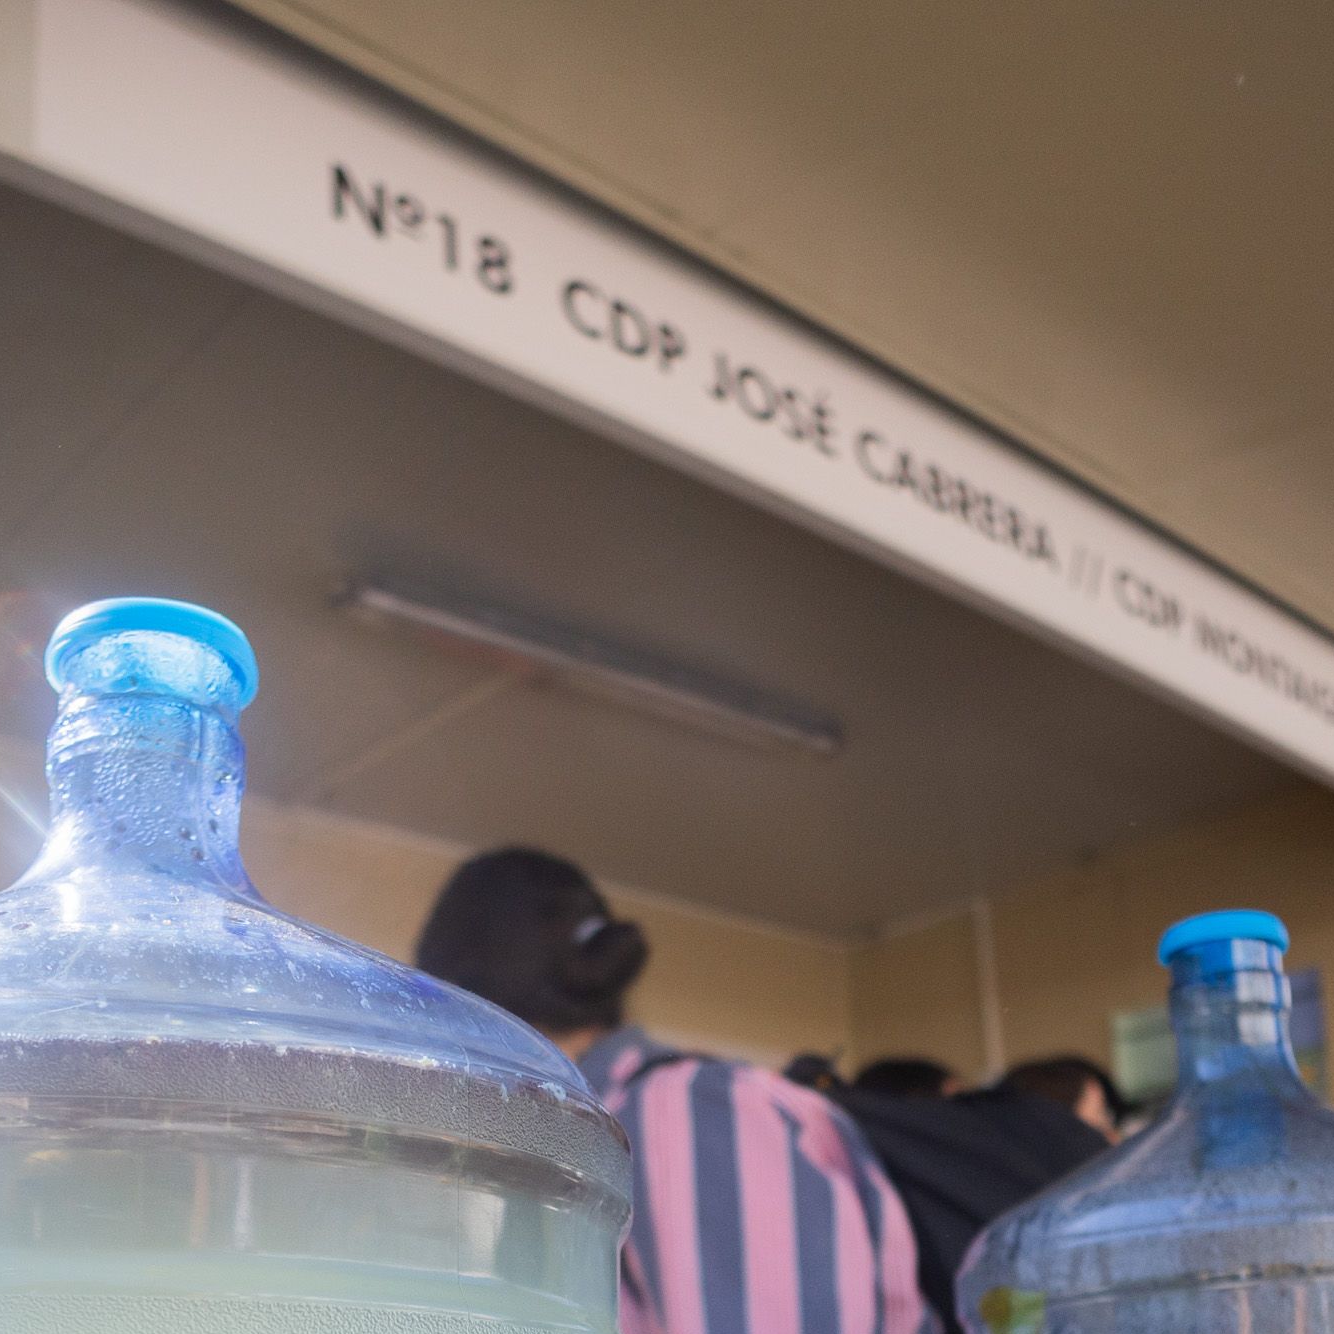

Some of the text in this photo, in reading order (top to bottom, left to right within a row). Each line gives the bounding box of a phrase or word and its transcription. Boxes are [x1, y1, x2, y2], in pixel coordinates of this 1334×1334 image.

[560, 276, 688, 374] CDP
[710, 350, 841, 457] JOSÉ
[854, 428, 1059, 570] CABRERA
[1114, 568, 1182, 636] CDP
